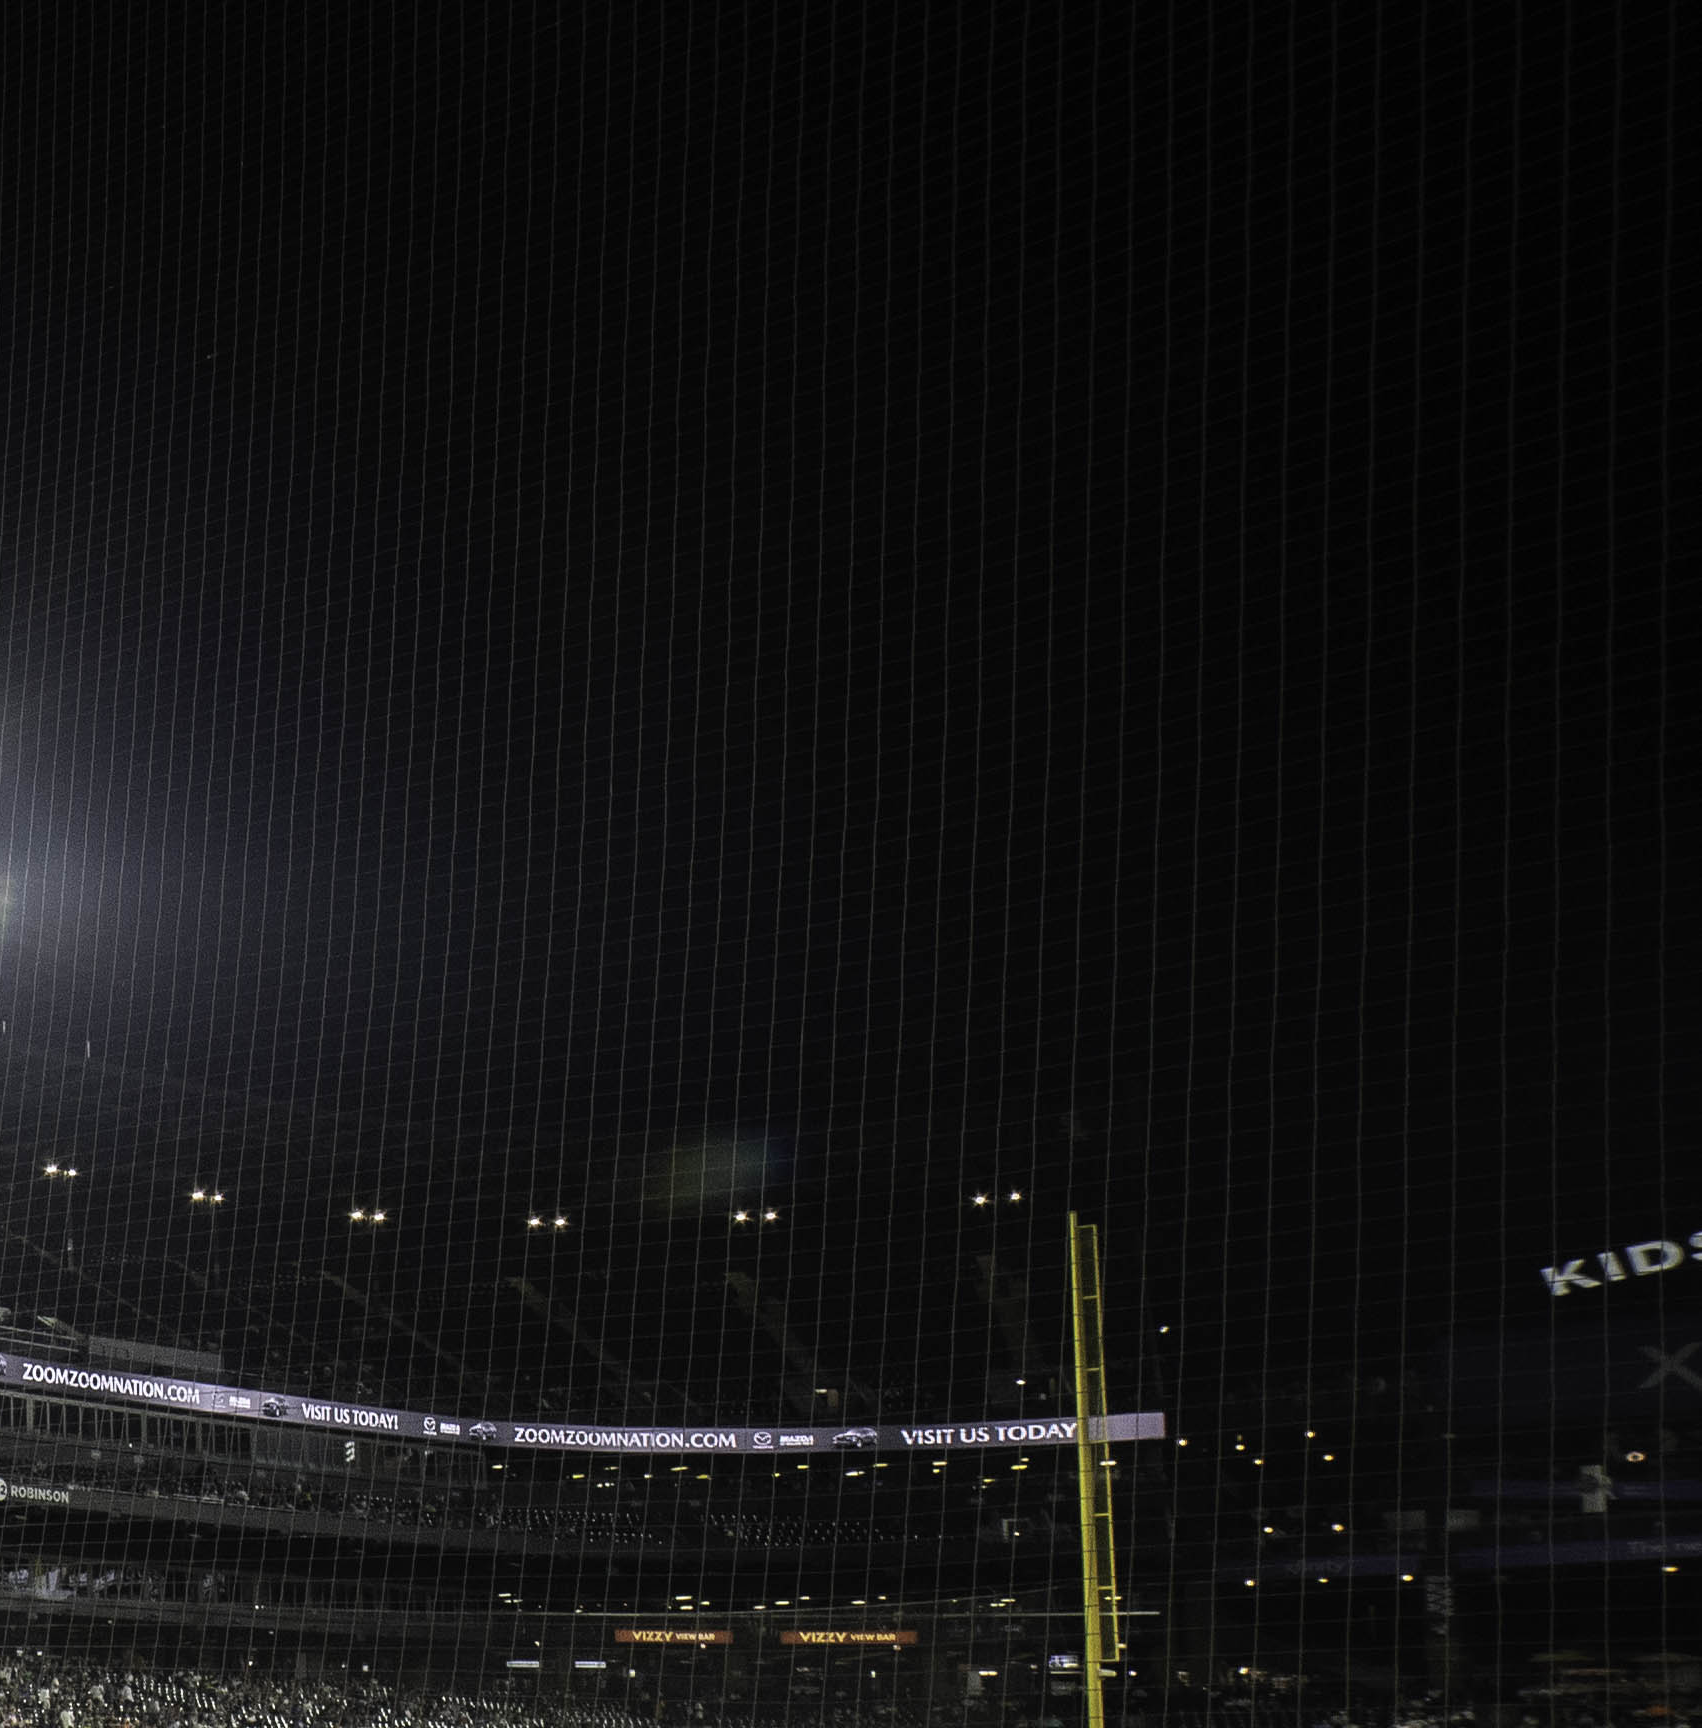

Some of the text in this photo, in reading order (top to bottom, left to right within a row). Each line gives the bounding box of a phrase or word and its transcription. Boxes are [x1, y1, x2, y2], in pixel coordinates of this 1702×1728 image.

[23, 1363, 200, 1404] ZOOMZOOMNATION.COM
[300, 1403, 398, 1430] VISIT US TODAY!
[514, 1428, 737, 1449] ZOOMZOOMNATION.COM
[901, 1428, 955, 1446] VISIT
[959, 1427, 991, 1443] US
[10, 1485, 70, 1504] ROBINSON
[632, 1631, 674, 1641] VIZZY
[799, 1631, 847, 1643] VIZZY
